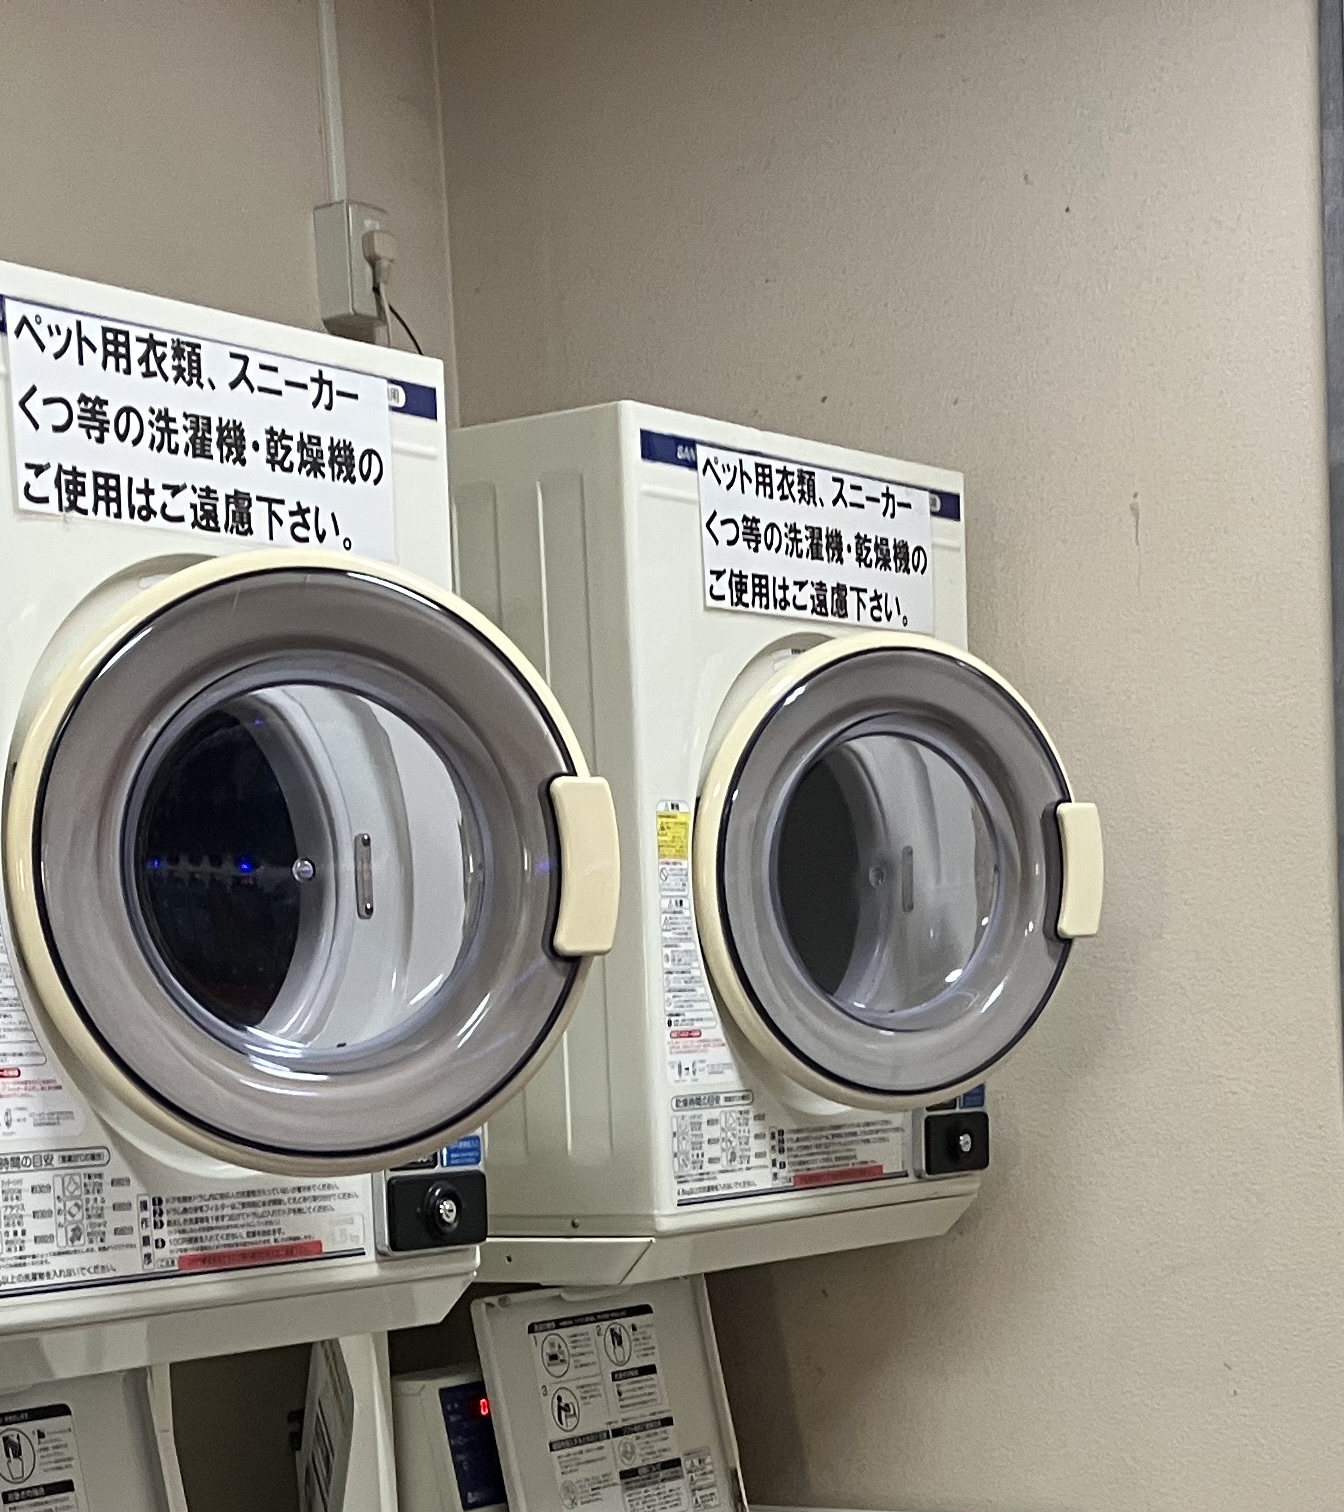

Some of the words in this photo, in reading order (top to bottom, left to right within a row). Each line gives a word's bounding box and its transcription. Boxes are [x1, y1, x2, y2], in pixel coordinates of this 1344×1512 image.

[14, 312, 359, 411] ペット用衣類、スニーカー
[18, 384, 384, 487] くつ等の洗濯機・乾燥機の
[22, 461, 353, 551] ご使用はご遠慮下さい。
[702, 456, 912, 519] ペット用衣類、スニーカー
[705, 510, 928, 575] くつ等の洗濯機・乾燥機の
[709, 568, 909, 627] ご使用はご遠慮下さい。
